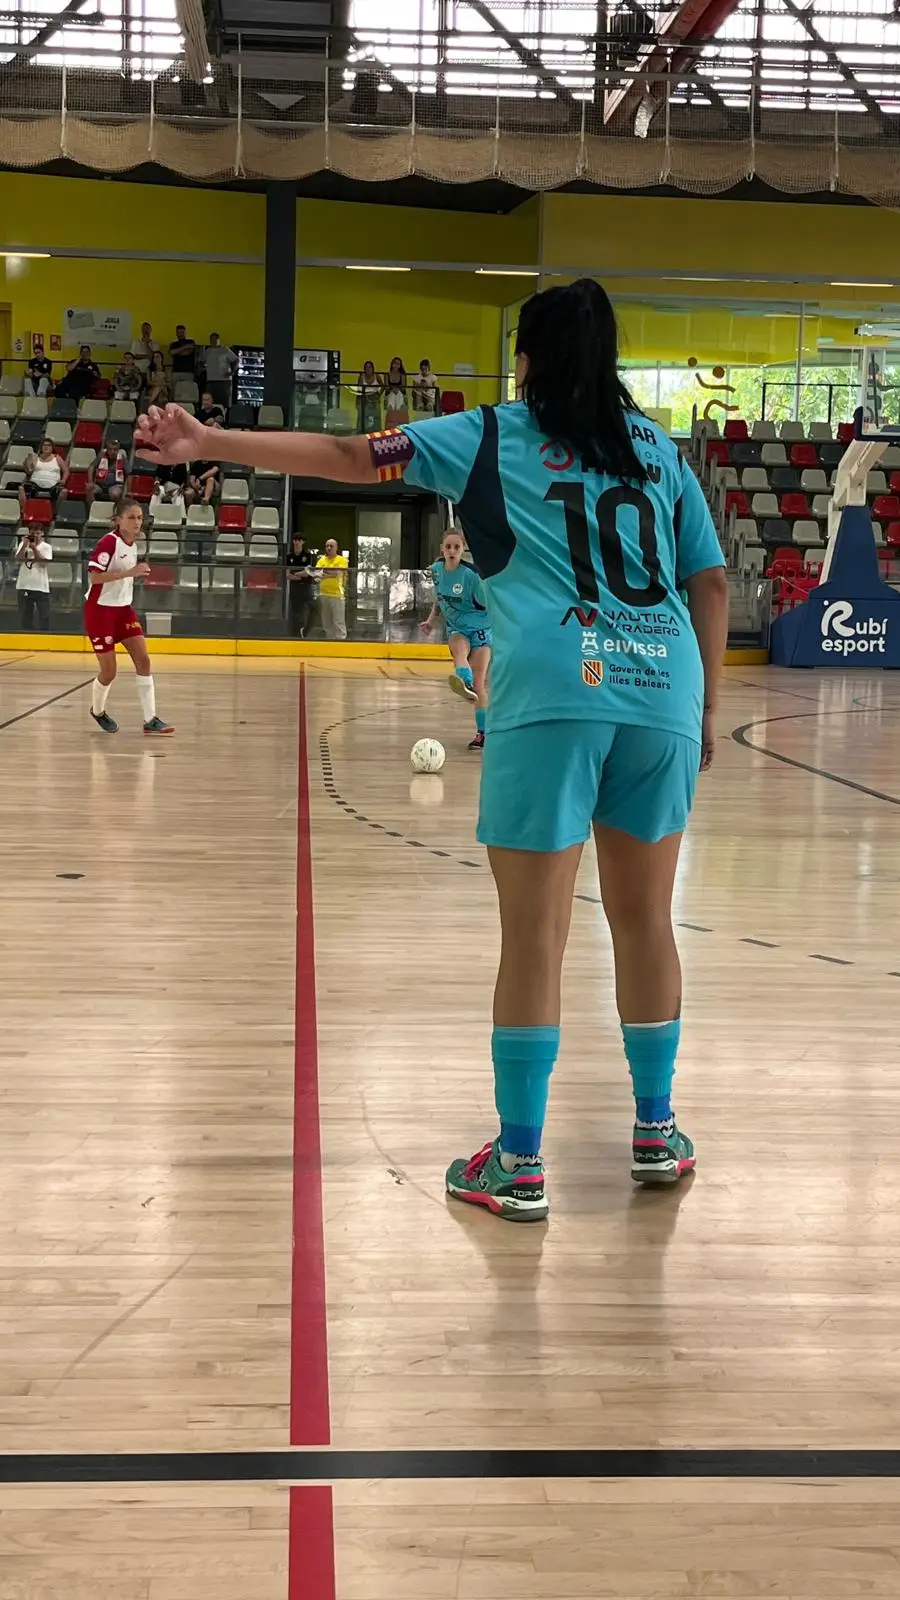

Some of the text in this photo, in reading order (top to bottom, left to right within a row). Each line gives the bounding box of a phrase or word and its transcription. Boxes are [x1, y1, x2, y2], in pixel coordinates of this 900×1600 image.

[543, 481, 668, 607] 10
[821, 600, 888, 637] Rubí
[605, 620, 680, 637] VARADERO
[821, 636, 886, 657] esport
[608, 663, 642, 675] Govern
[644, 667, 656, 676] de
[609, 674, 671, 690] Illes Balears
